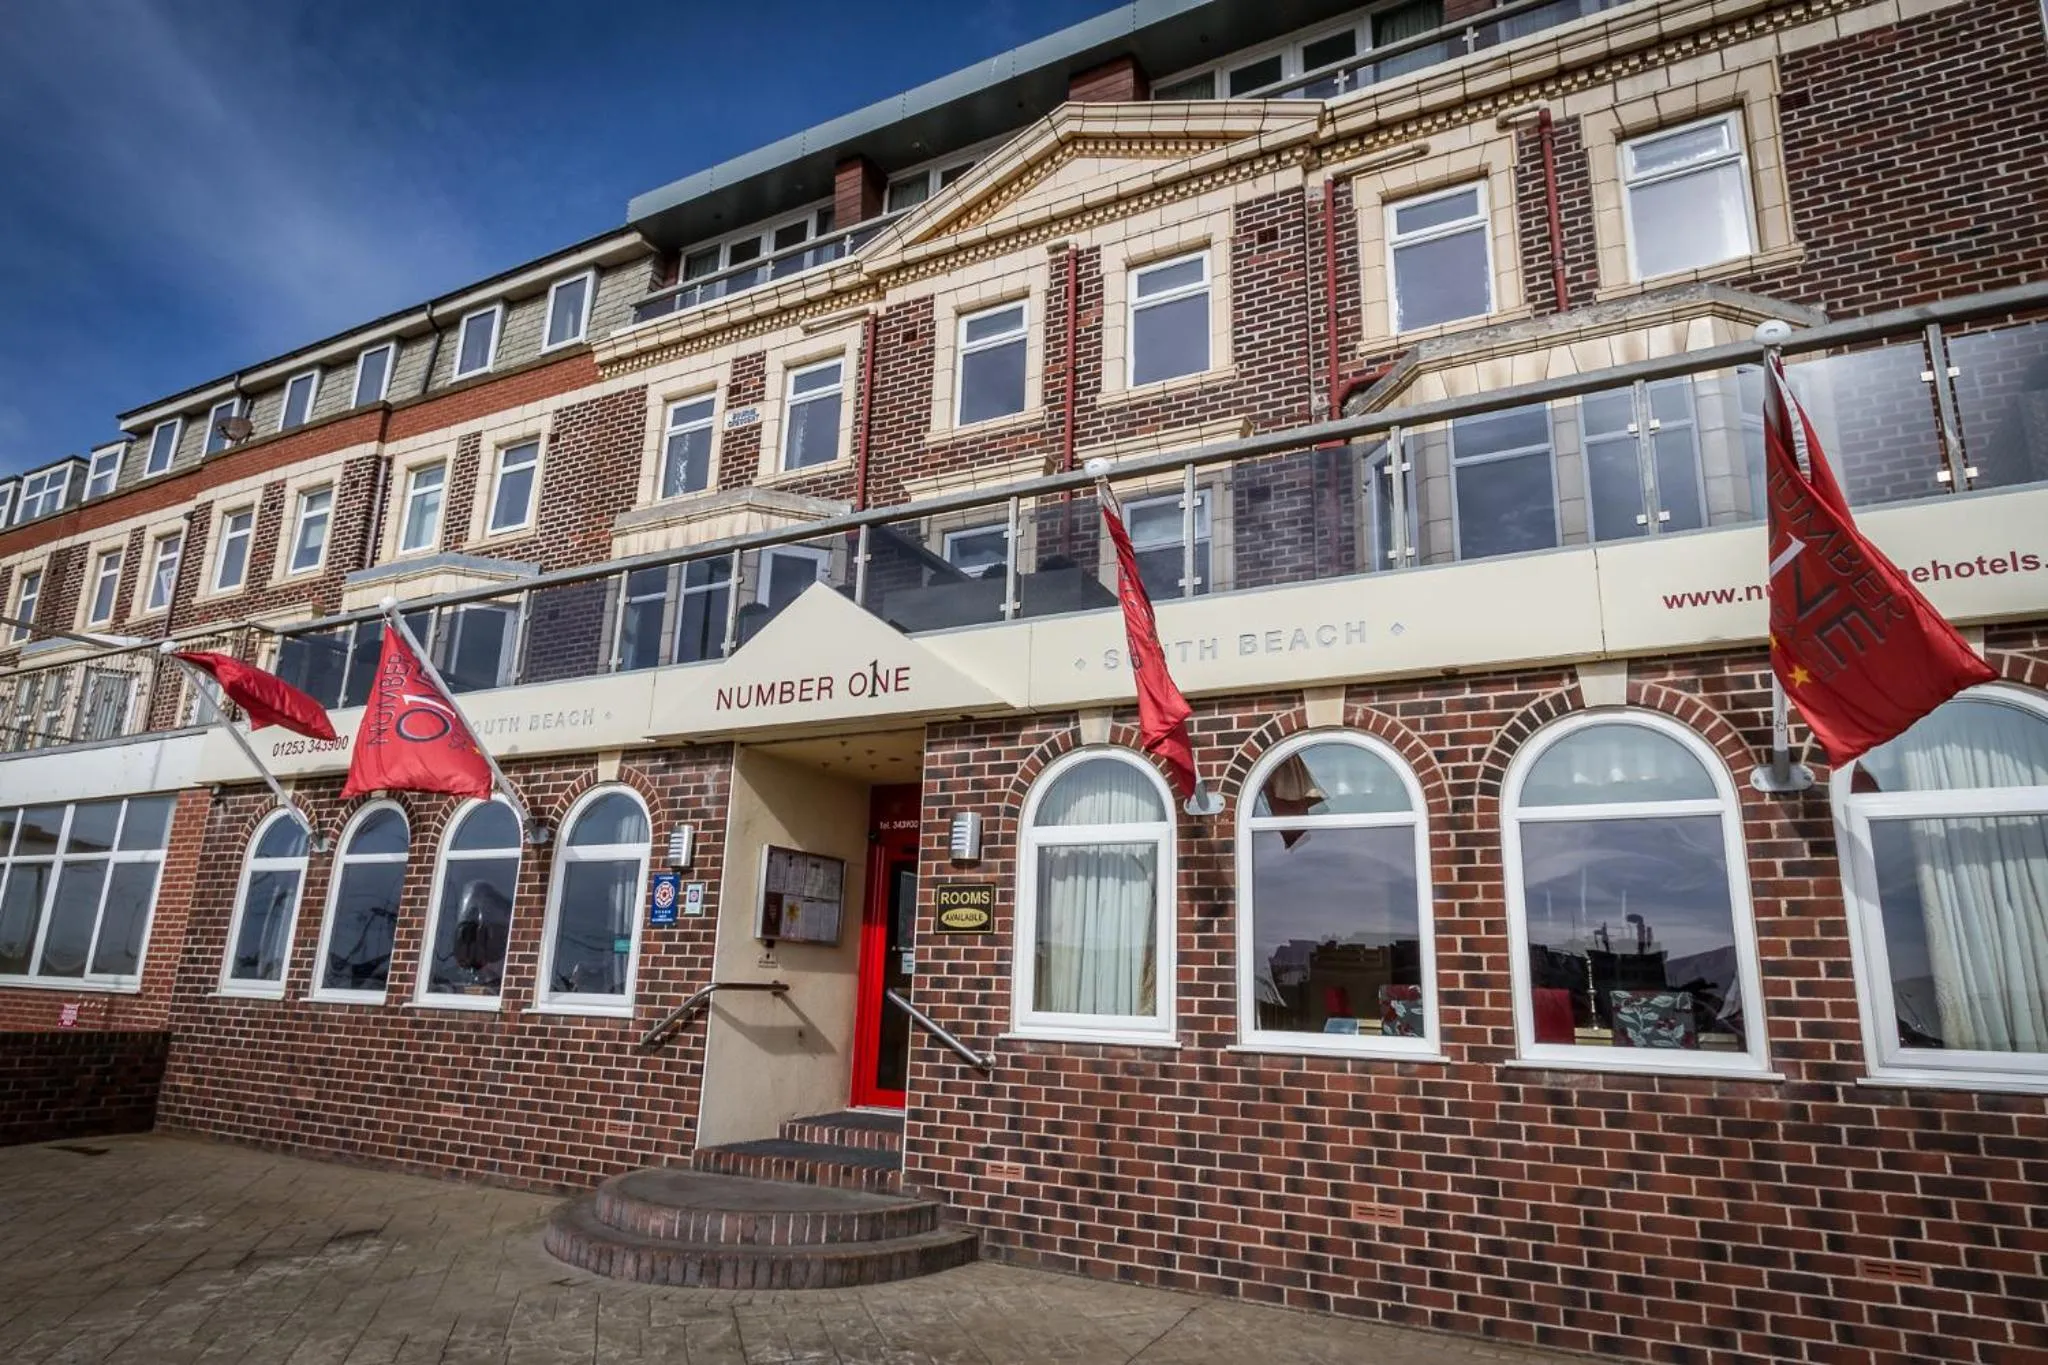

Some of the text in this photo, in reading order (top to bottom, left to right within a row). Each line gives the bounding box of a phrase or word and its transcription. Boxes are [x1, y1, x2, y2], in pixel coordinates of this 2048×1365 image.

[1103, 637, 1218, 670] STH
[1239, 620, 1366, 656] BEACH
[716, 676, 834, 711] NUMBER
[472, 707, 594, 735] OUTH BEACH
[272, 735, 349, 757] 01253 343900
[940, 891, 990, 905] ROOMS
[944, 912, 984, 922] AVAILABLE
